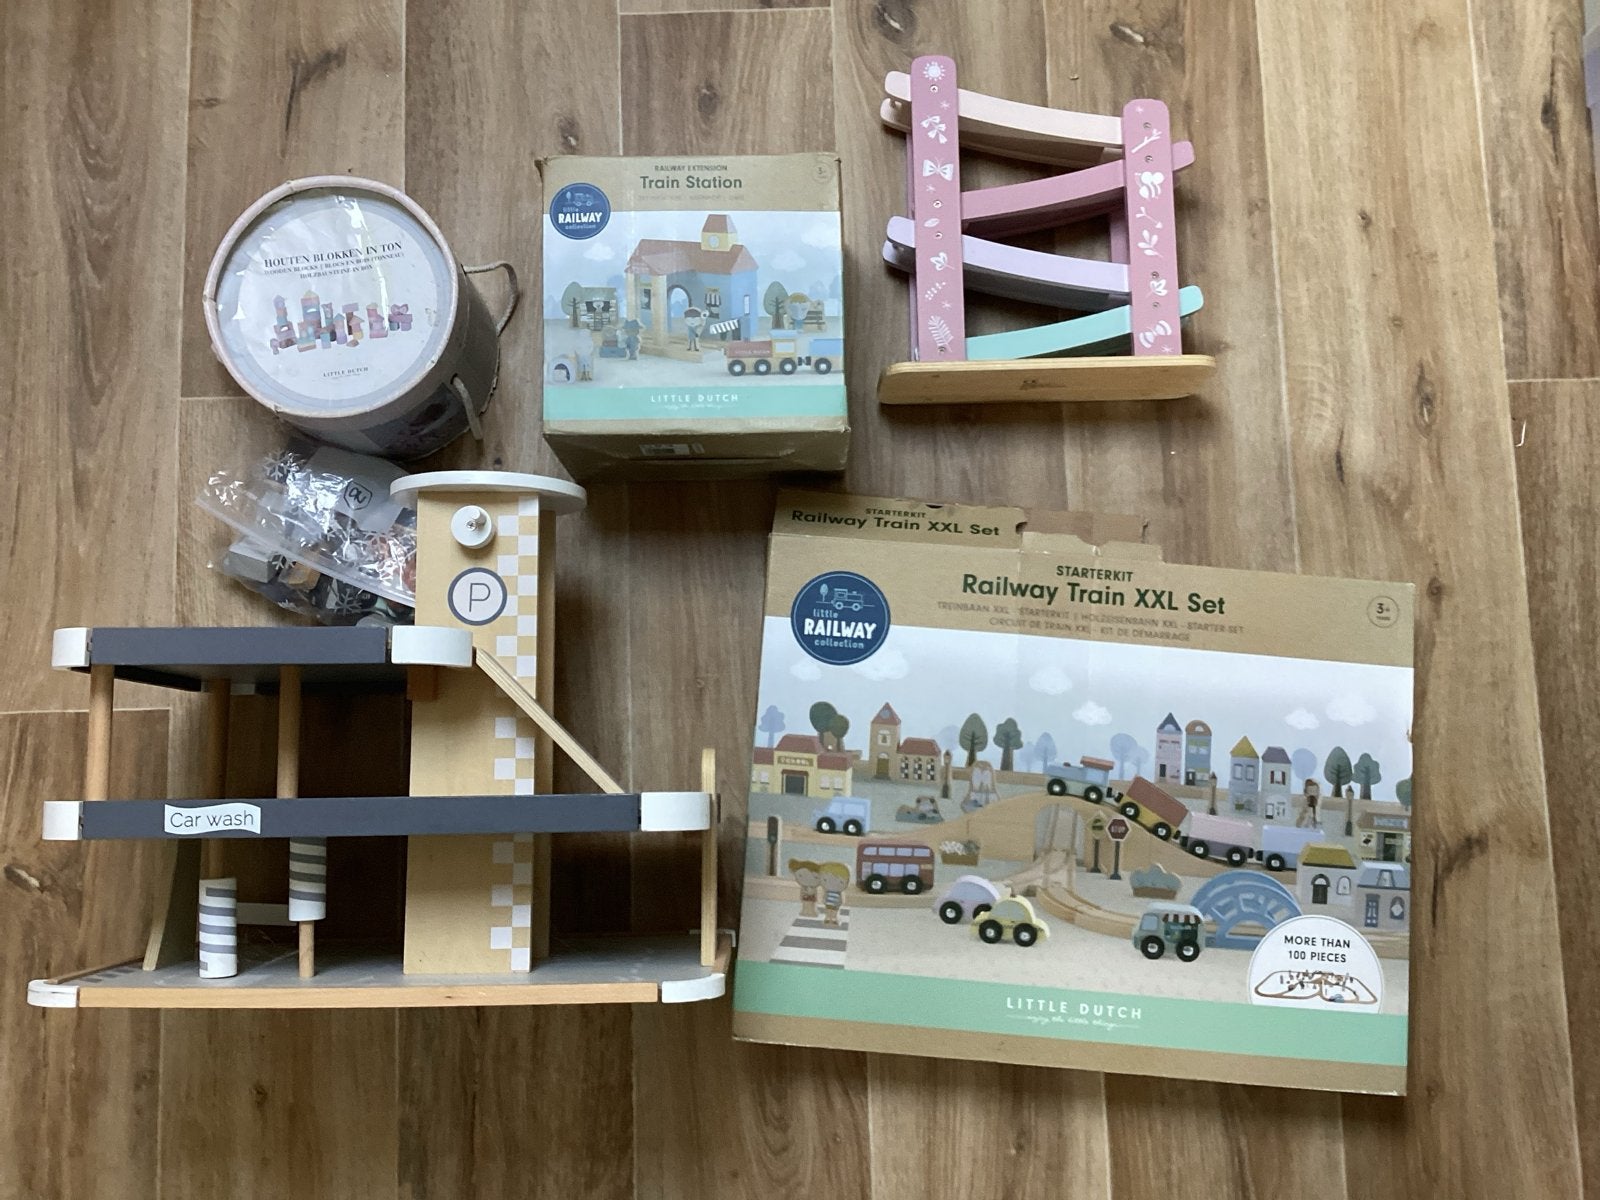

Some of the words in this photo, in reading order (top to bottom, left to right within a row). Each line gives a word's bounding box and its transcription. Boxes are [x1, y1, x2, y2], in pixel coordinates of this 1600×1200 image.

[640, 175, 680, 189] Train
[686, 175, 742, 189] Station
[558, 211, 603, 224] RAILWAY
[264, 255, 310, 268] HOUTEN
[313, 247, 363, 262] BLOKKEN
[366, 245, 377, 255] IN
[381, 240, 402, 253] TON
[322, 370, 345, 378] LITTLE
[650, 394, 689, 403] LITTLE
[698, 394, 738, 402] DUTCH
[865, 508, 926, 519] STARTERKIT
[791, 510, 867, 529] Railway
[873, 517, 920, 531] Train
[927, 520, 963, 534] XXL
[969, 524, 1000, 536] Set
[1056, 565, 1133, 582] STARTERKIT
[468, 583, 491, 613] P
[962, 573, 1059, 606] Railway
[1067, 582, 1125, 606] Train
[1133, 588, 1179, 611] XXL
[1187, 592, 1226, 614] Set
[812, 608, 839, 619] little
[803, 617, 877, 640] RAILWAY
[814, 637, 865, 650] collection
[170, 812, 202, 828] Car
[206, 809, 254, 827] wash
[1284, 934, 1317, 947] MORE
[1320, 937, 1351, 949] THAN
[1288, 950, 1306, 960] 100
[1310, 951, 1347, 963] PIECES
[1006, 996, 1068, 1013] LITTLE
[1079, 1002, 1142, 1020] DUTCH
